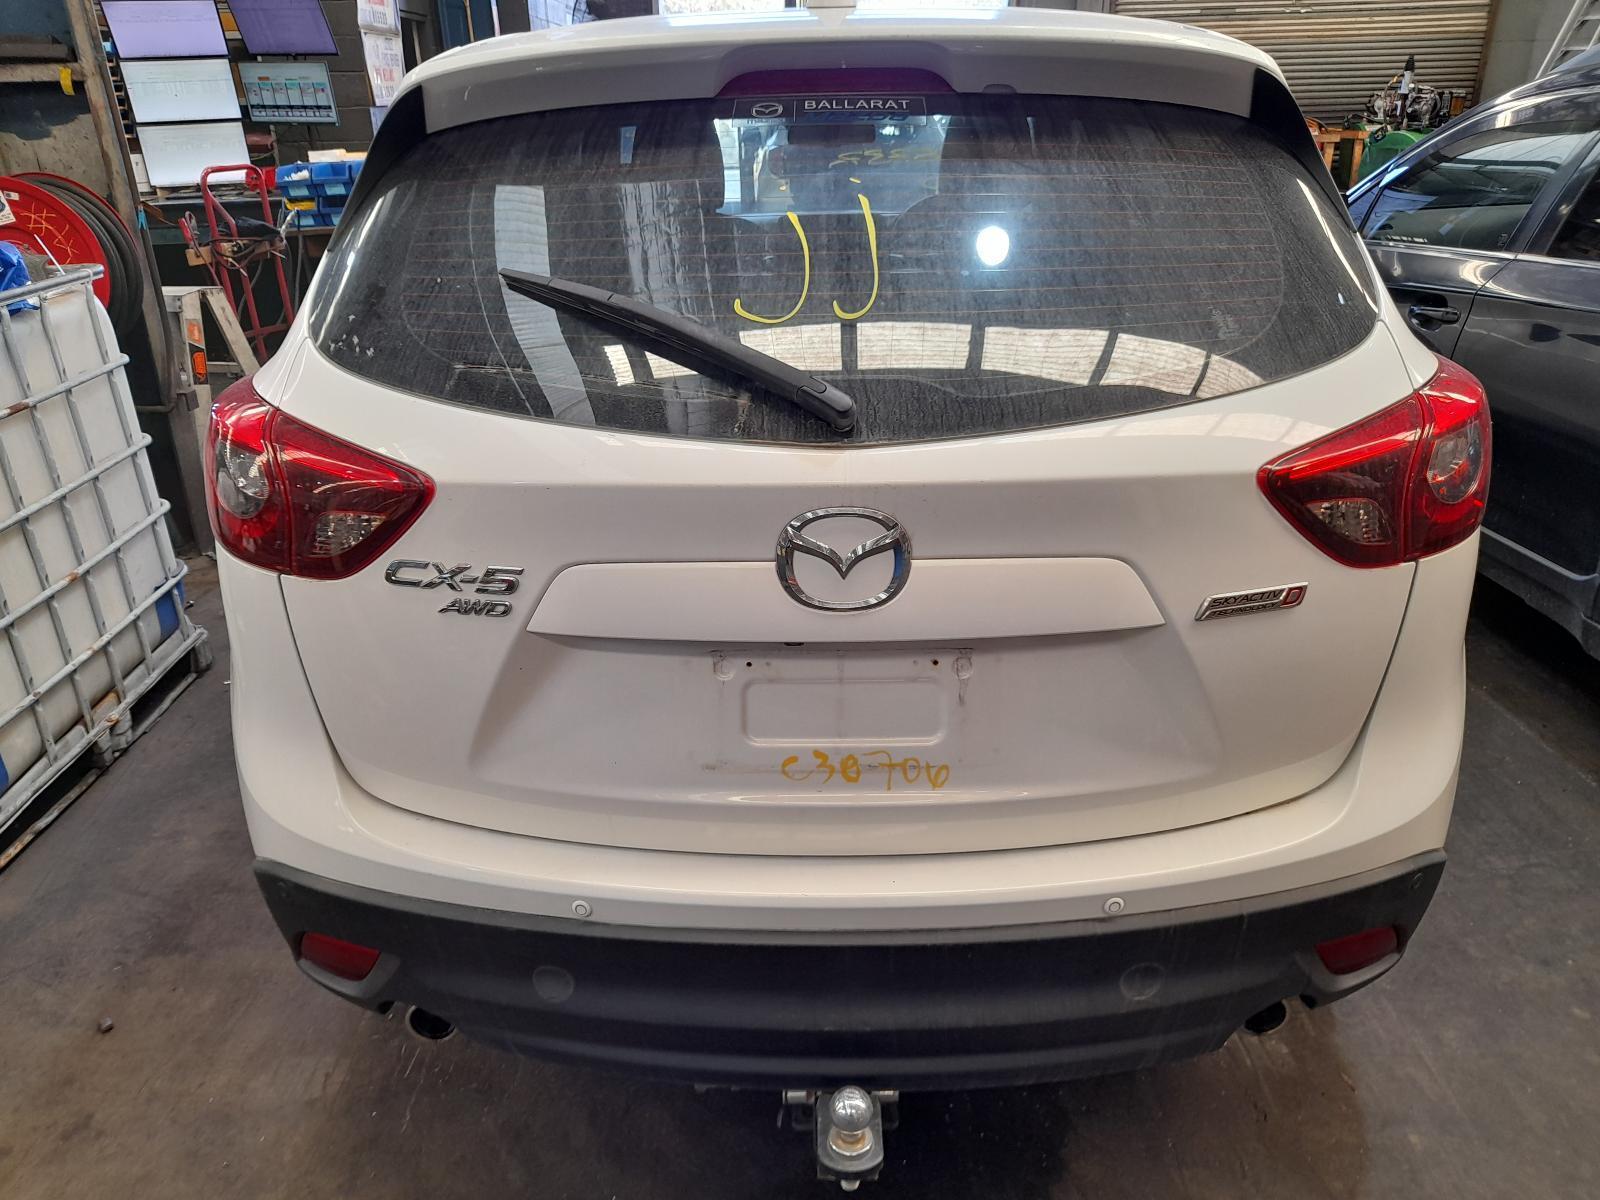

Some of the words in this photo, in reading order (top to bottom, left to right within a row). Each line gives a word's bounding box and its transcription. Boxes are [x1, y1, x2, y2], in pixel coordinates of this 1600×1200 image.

[804, 100, 910, 110] BALLARAT
[384, 558, 525, 596] CX-5
[438, 598, 513, 618] AWD
[1210, 591, 1281, 608] SKYACTIV
